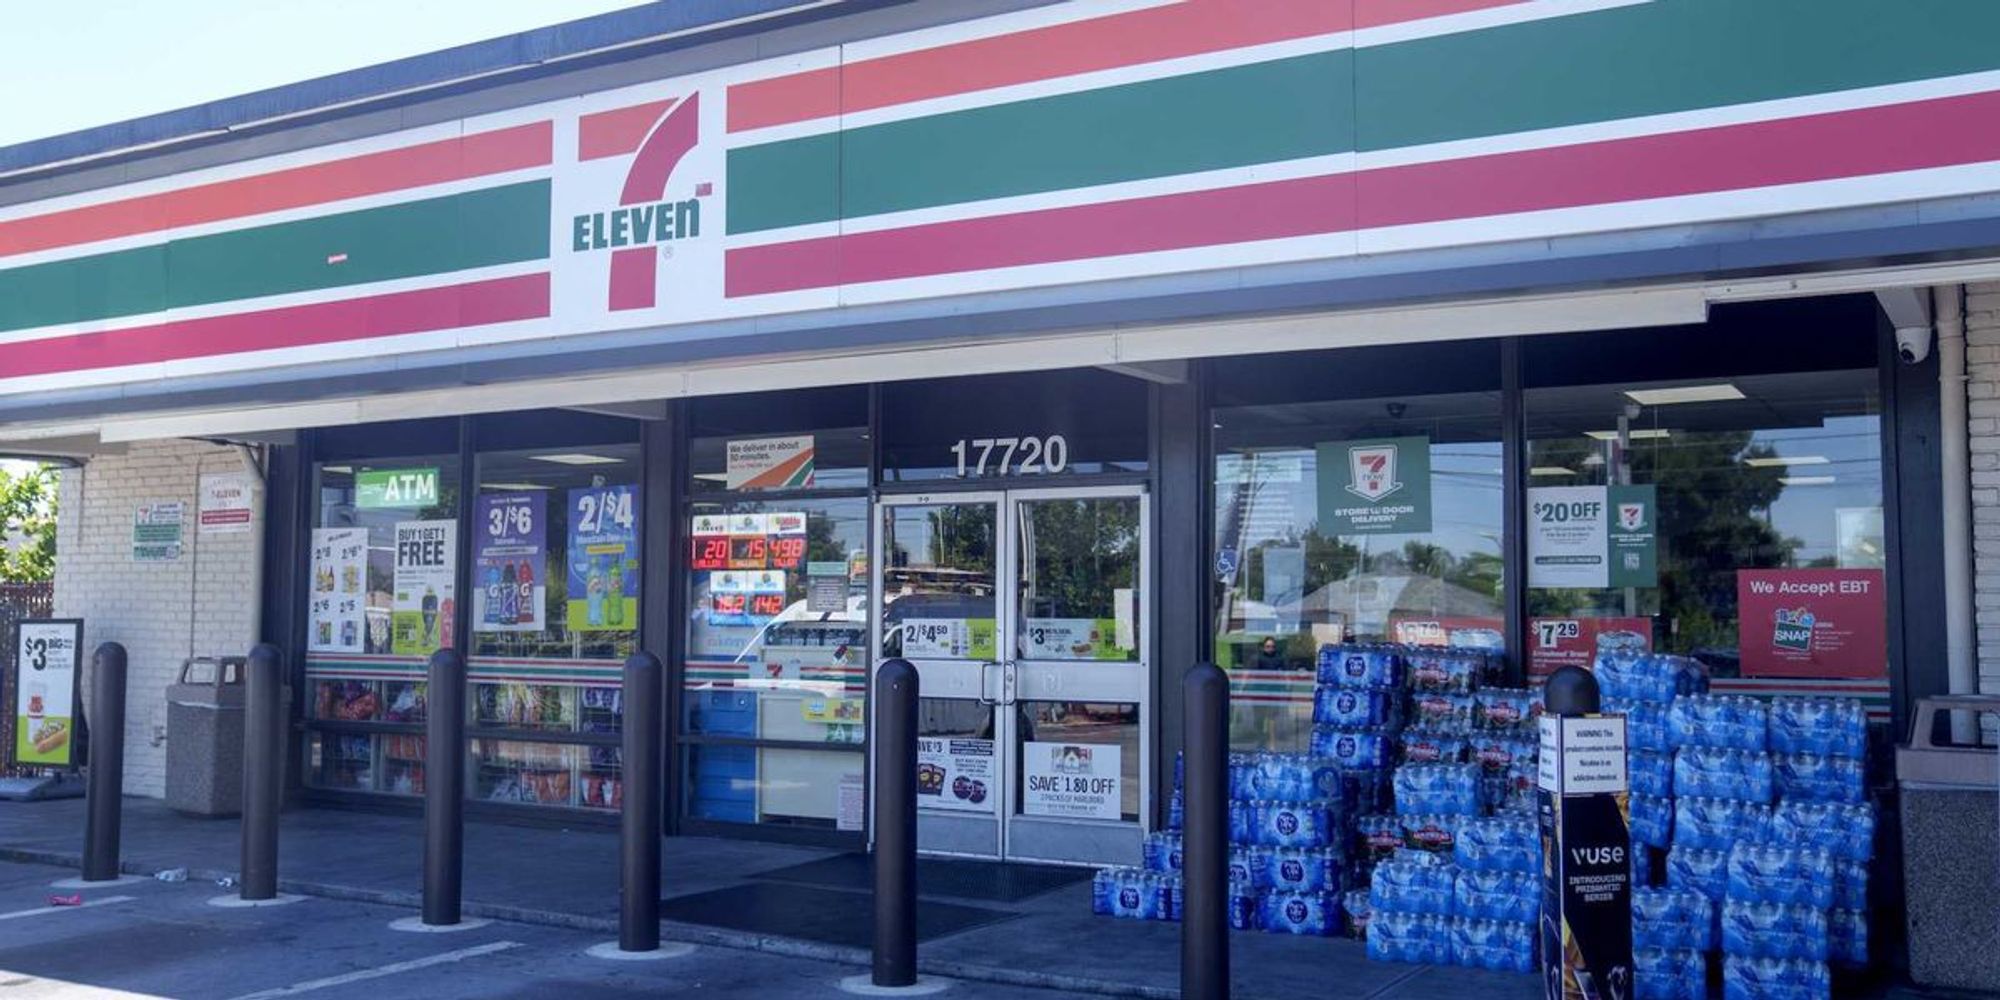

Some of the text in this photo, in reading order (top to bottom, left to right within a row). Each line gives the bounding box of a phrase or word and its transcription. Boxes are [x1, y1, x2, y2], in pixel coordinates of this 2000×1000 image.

[578, 90, 700, 312] 7
[743, 443, 767, 452] deliver
[777, 441, 799, 450] about
[950, 435, 1068, 476] 17720
[384, 473, 435, 501] ATM
[489, 506, 532, 537] 3/$6
[578, 491, 633, 533] 2/$4
[1351, 515, 1397, 524] DELIVERY
[1534, 502, 1601, 522] $20 OFF
[398, 529, 417, 541] BUY
[423, 528, 440, 540] GET
[398, 541, 445, 567] FREE
[705, 541, 727, 559] 20
[747, 539, 765, 558] 15
[1750, 581, 1871, 597] We Accept EBT
[1029, 628, 1045, 645] $3
[1775, 630, 1811, 641] SNAP
[25, 637, 47, 671] $3
[1029, 775, 1060, 792] SAVE
[1091, 778, 1115, 795] OFF
